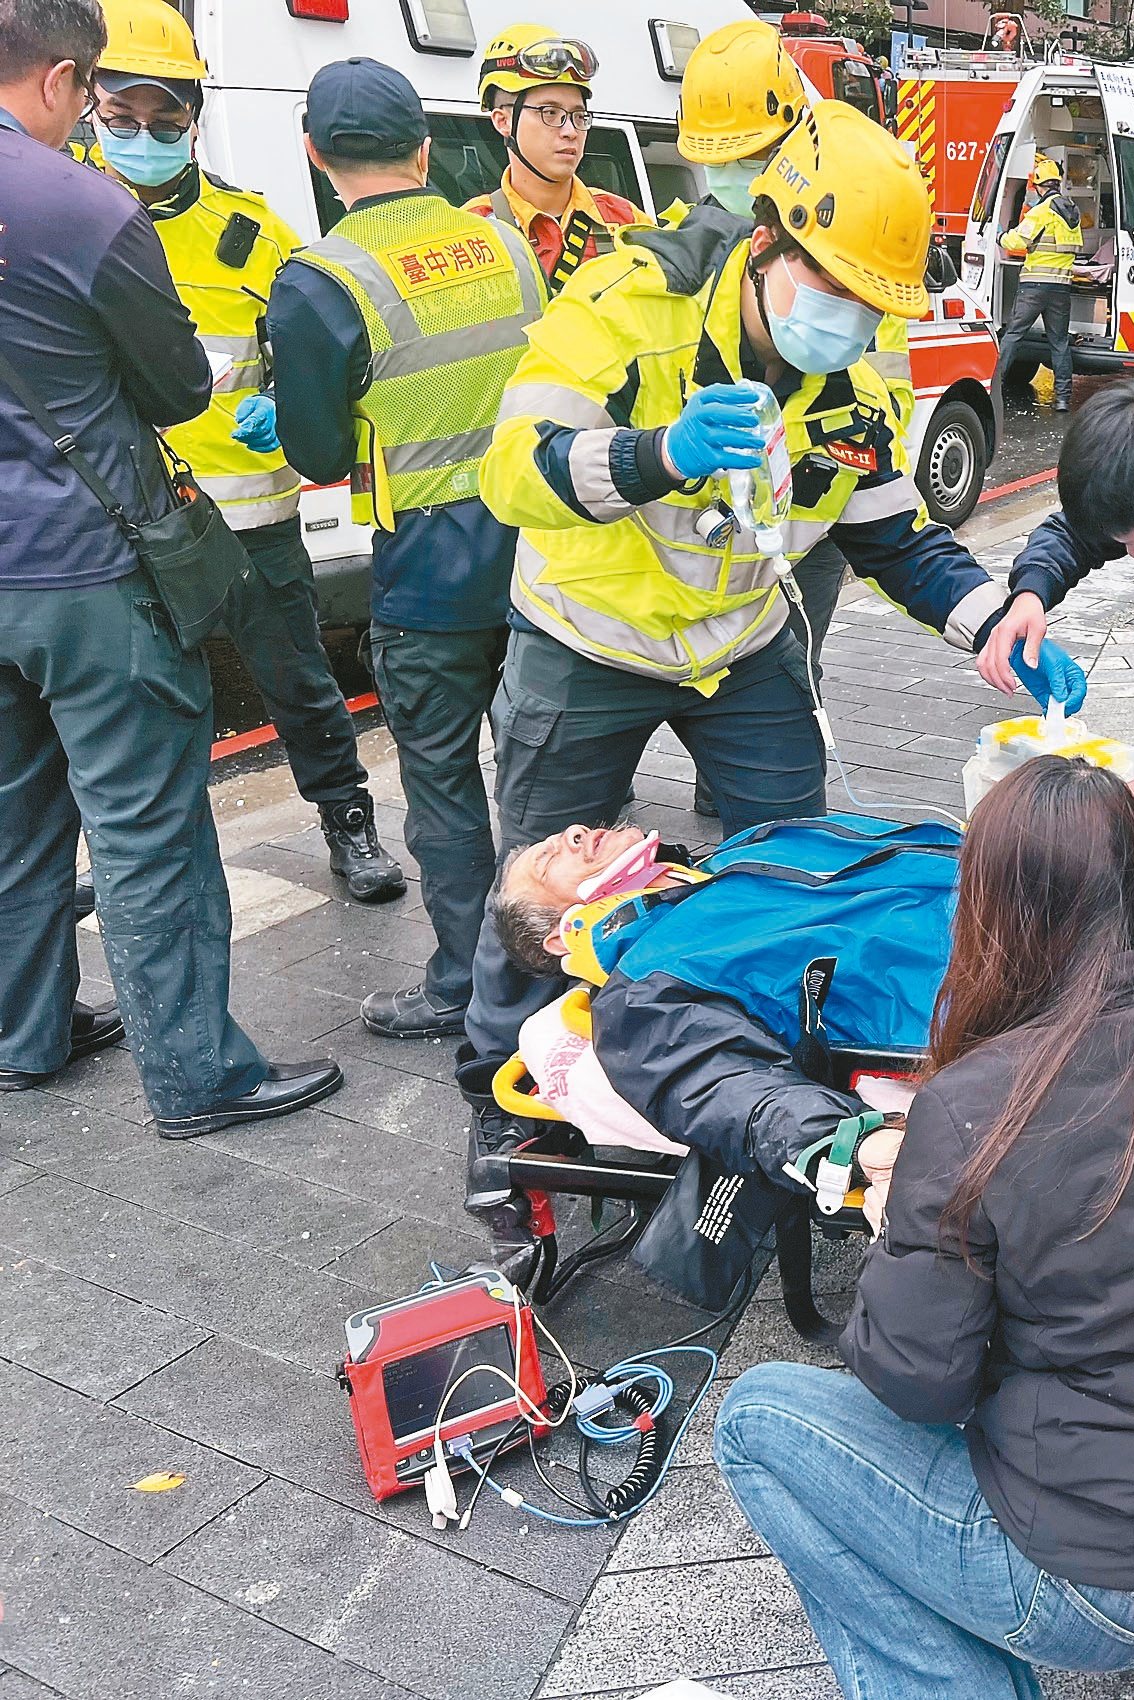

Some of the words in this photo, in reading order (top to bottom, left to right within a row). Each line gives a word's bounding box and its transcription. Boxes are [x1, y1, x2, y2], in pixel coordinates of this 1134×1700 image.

[776, 156, 811, 195] EMT
[398, 237, 494, 285] 臺中消防
[828, 444, 871, 465] EMT-II
